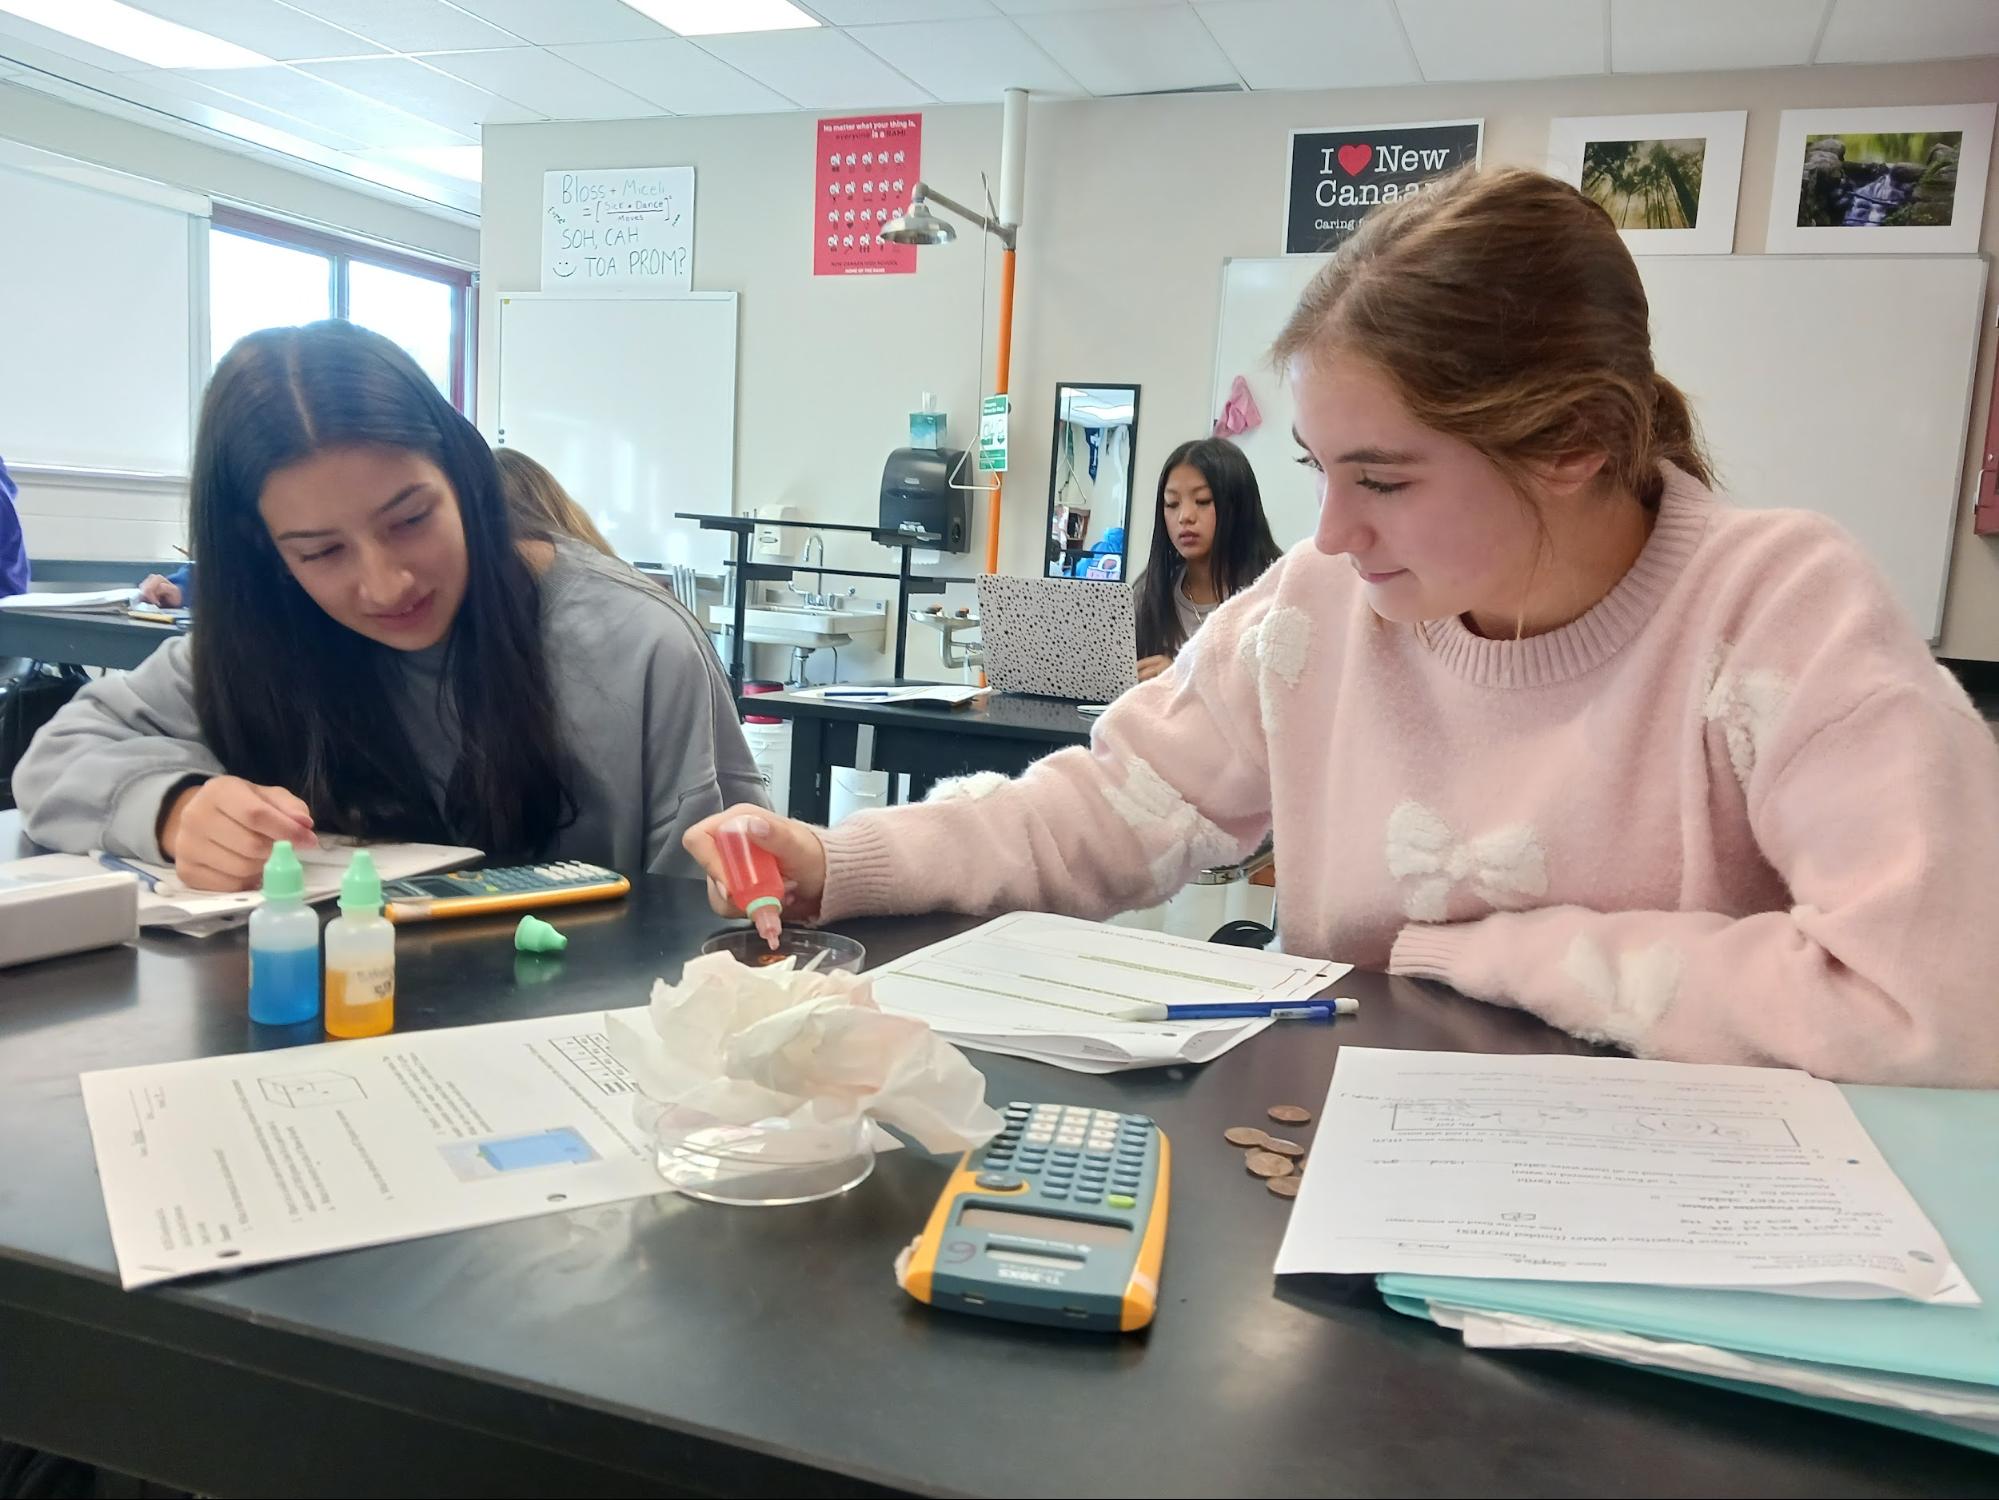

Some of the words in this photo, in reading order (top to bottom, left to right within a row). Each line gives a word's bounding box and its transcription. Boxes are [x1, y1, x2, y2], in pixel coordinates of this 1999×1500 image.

[1319, 148, 1334, 174] I
[1374, 145, 1450, 173] New
[561, 174, 605, 205] Bloss
[605, 227, 639, 246] CAH
[1314, 218, 1355, 231] Caring
[584, 257, 617, 277] TOA
[629, 246, 687, 277] PROM?
